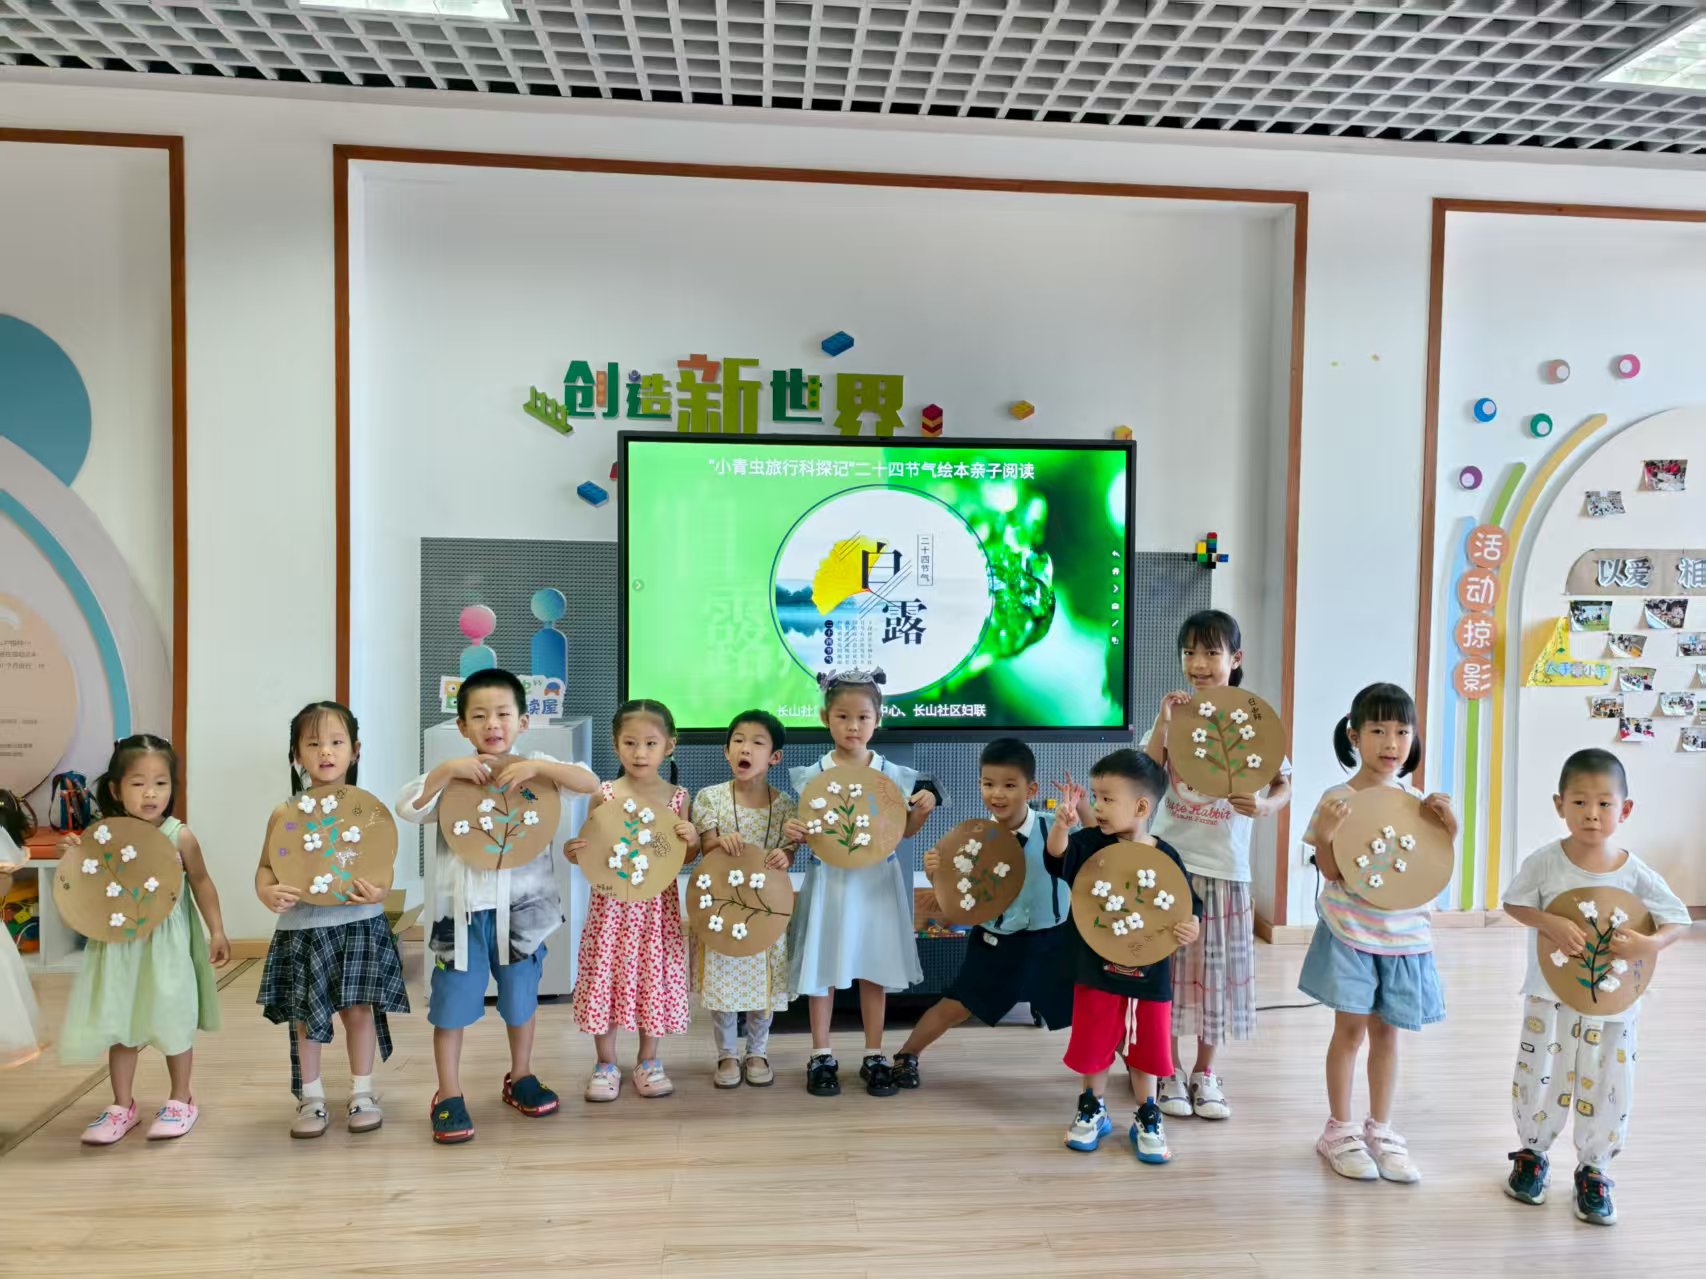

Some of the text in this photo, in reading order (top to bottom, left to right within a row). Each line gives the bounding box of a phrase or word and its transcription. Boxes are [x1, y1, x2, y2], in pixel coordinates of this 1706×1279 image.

[563, 353, 904, 436] 创造新世界
[920, 536, 931, 583] 二十四节气
[1598, 559, 1651, 588] 以爱
[1462, 533, 1504, 692] 活动掠影
